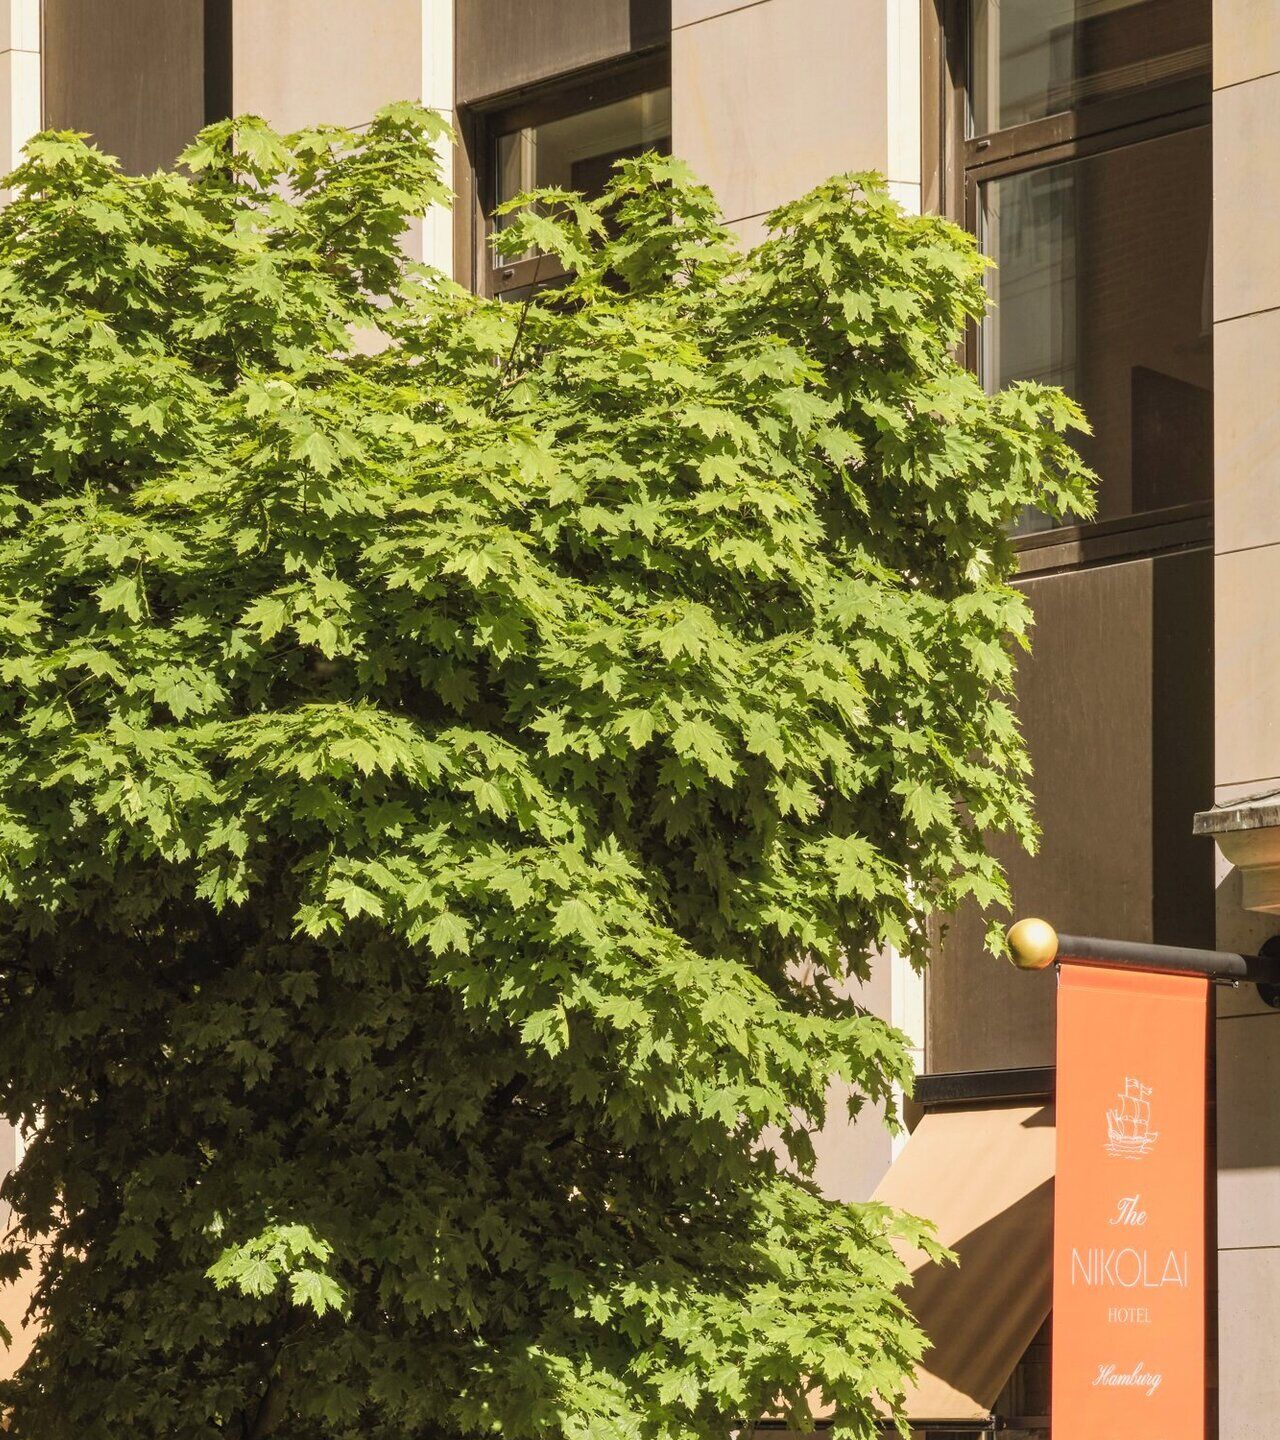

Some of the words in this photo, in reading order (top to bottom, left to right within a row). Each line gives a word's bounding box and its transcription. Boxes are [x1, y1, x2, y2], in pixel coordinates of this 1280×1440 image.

[1109, 1194, 1147, 1226] The
[1071, 1247, 1188, 1288] NIKOLAI
[1107, 1306, 1152, 1323] HOTEL
[1092, 1361, 1162, 1396] Hamburg
